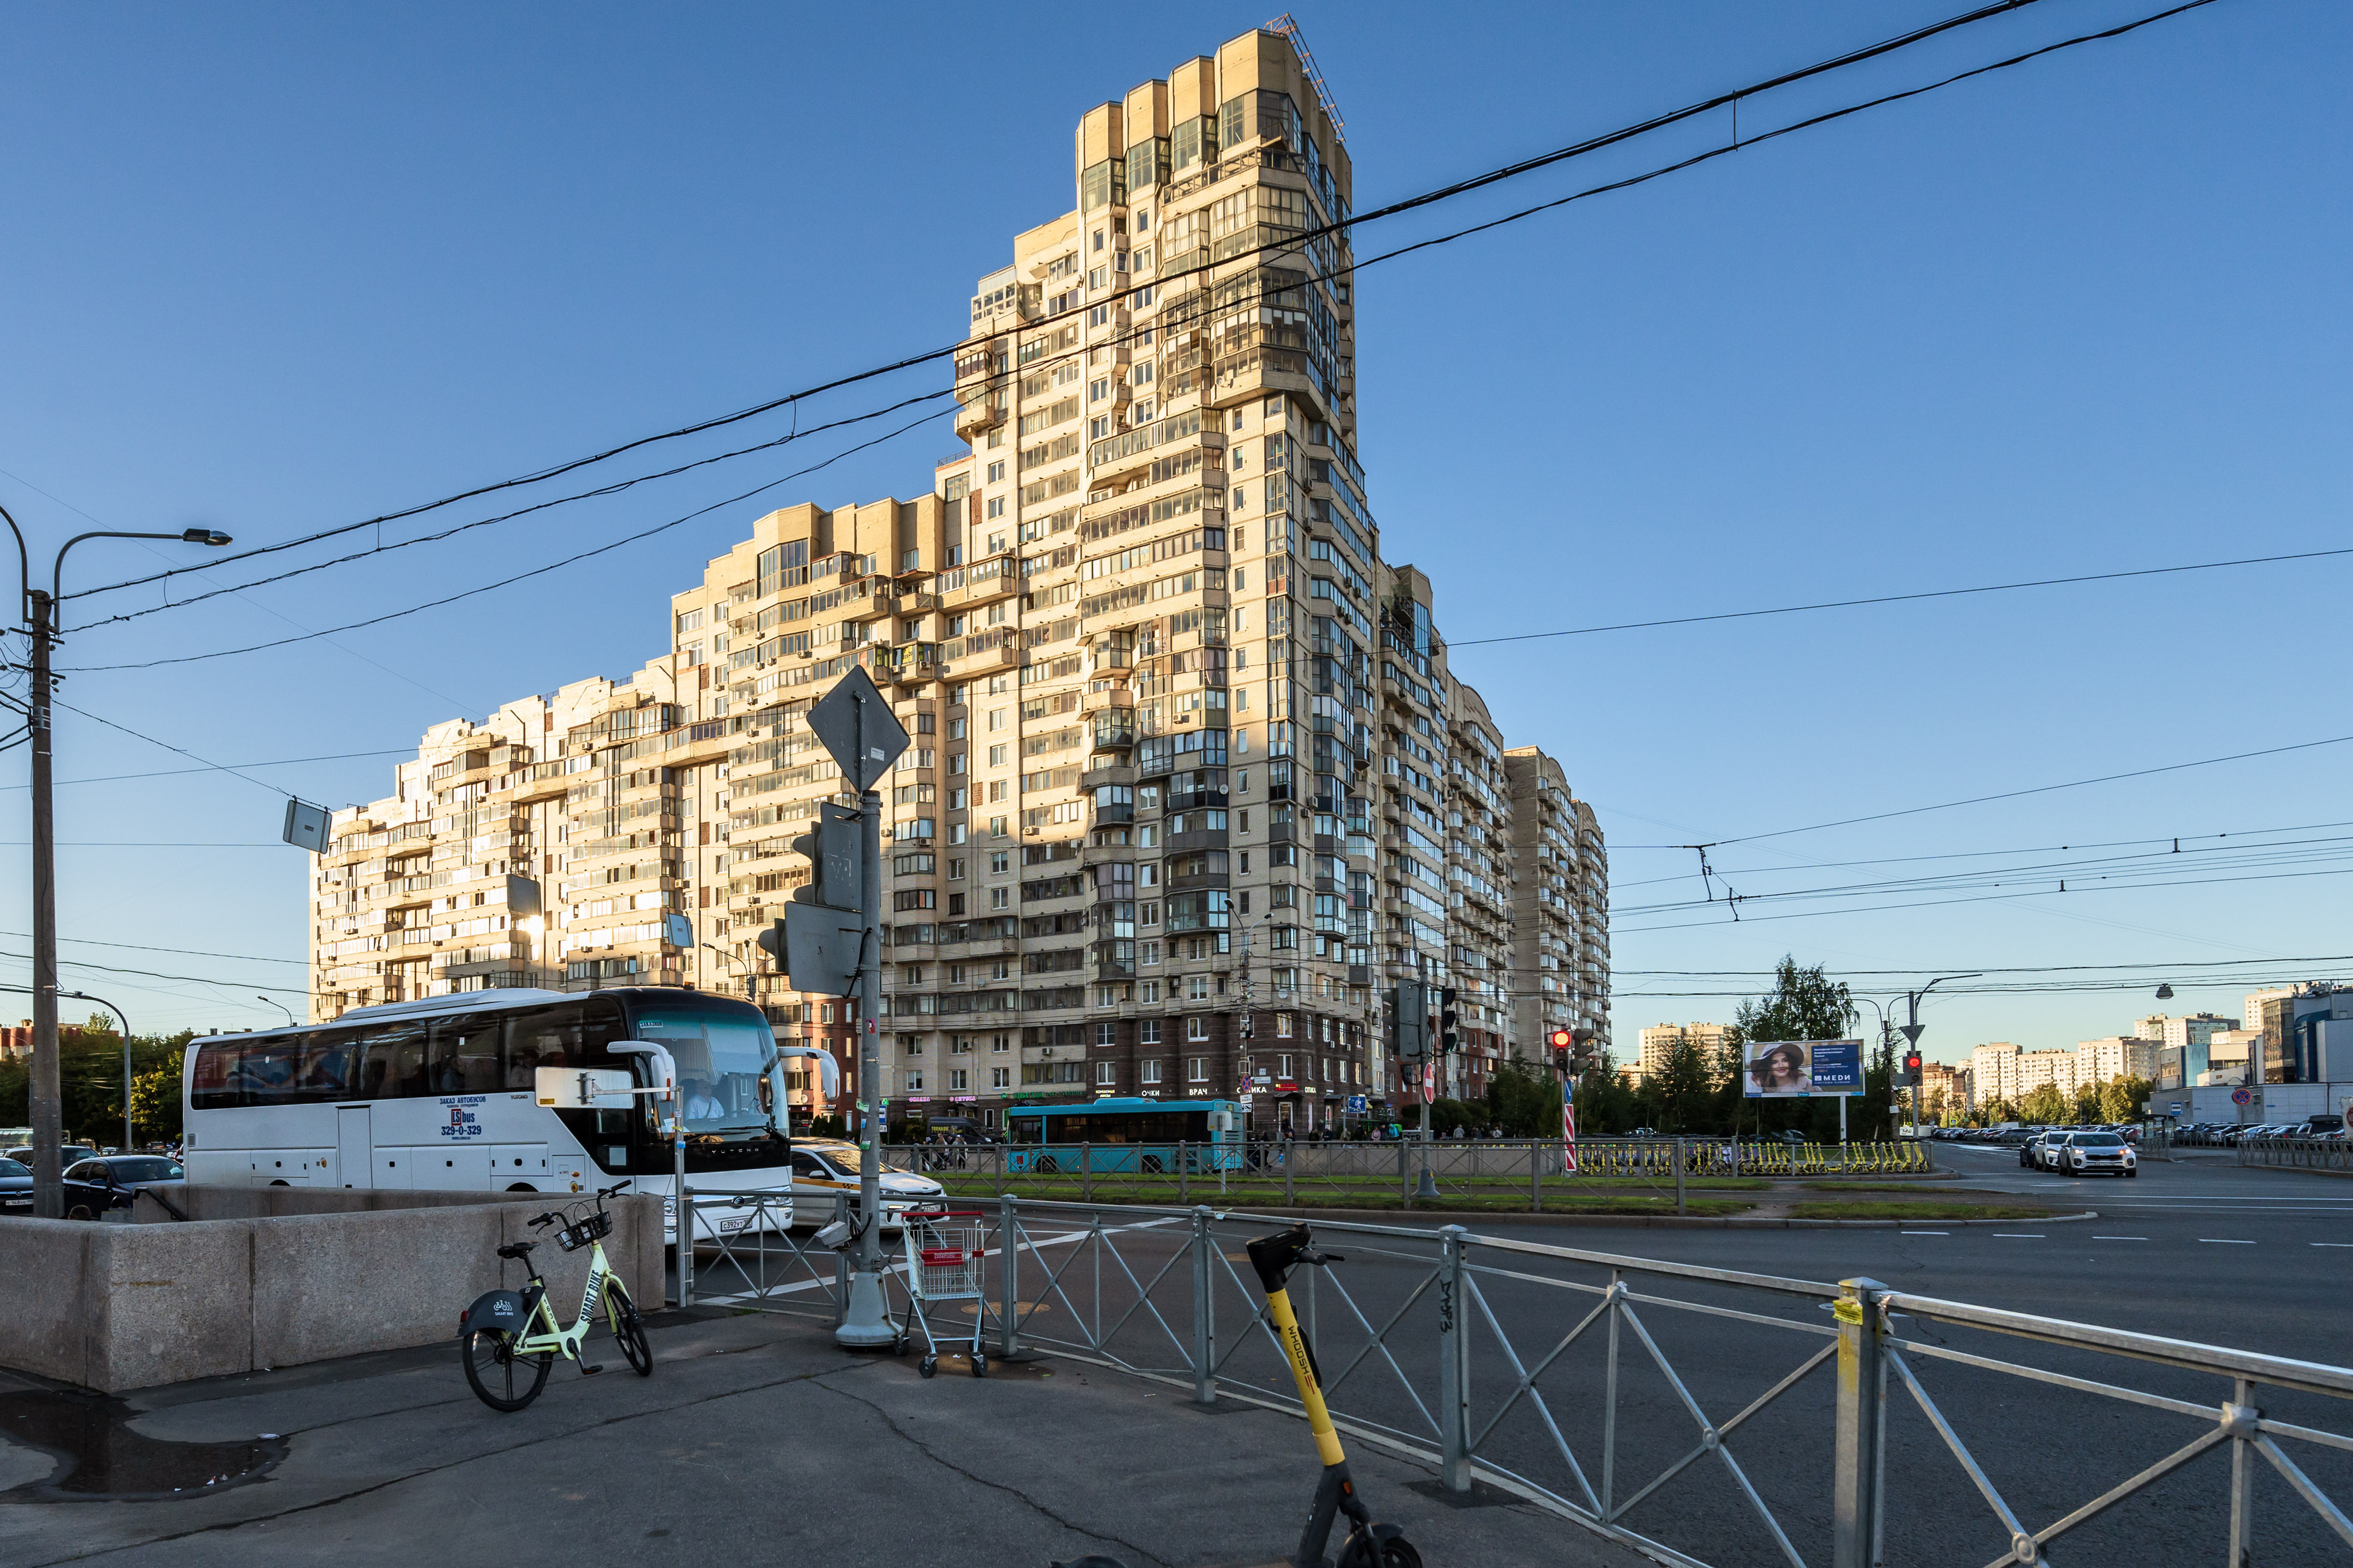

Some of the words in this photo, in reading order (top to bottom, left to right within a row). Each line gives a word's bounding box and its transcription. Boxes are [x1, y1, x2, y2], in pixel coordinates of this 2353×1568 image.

[462, 1111, 475, 1123] bus
[441, 1125, 482, 1135] 329-0-329
[723, 1221, 743, 1229] С392УТ
[588, 1270, 602, 1292] BIKE
[543, 1298, 556, 1326] 1631
[580, 1291, 597, 1324] SMART
[1288, 1325, 1309, 1374] WHOOSH
